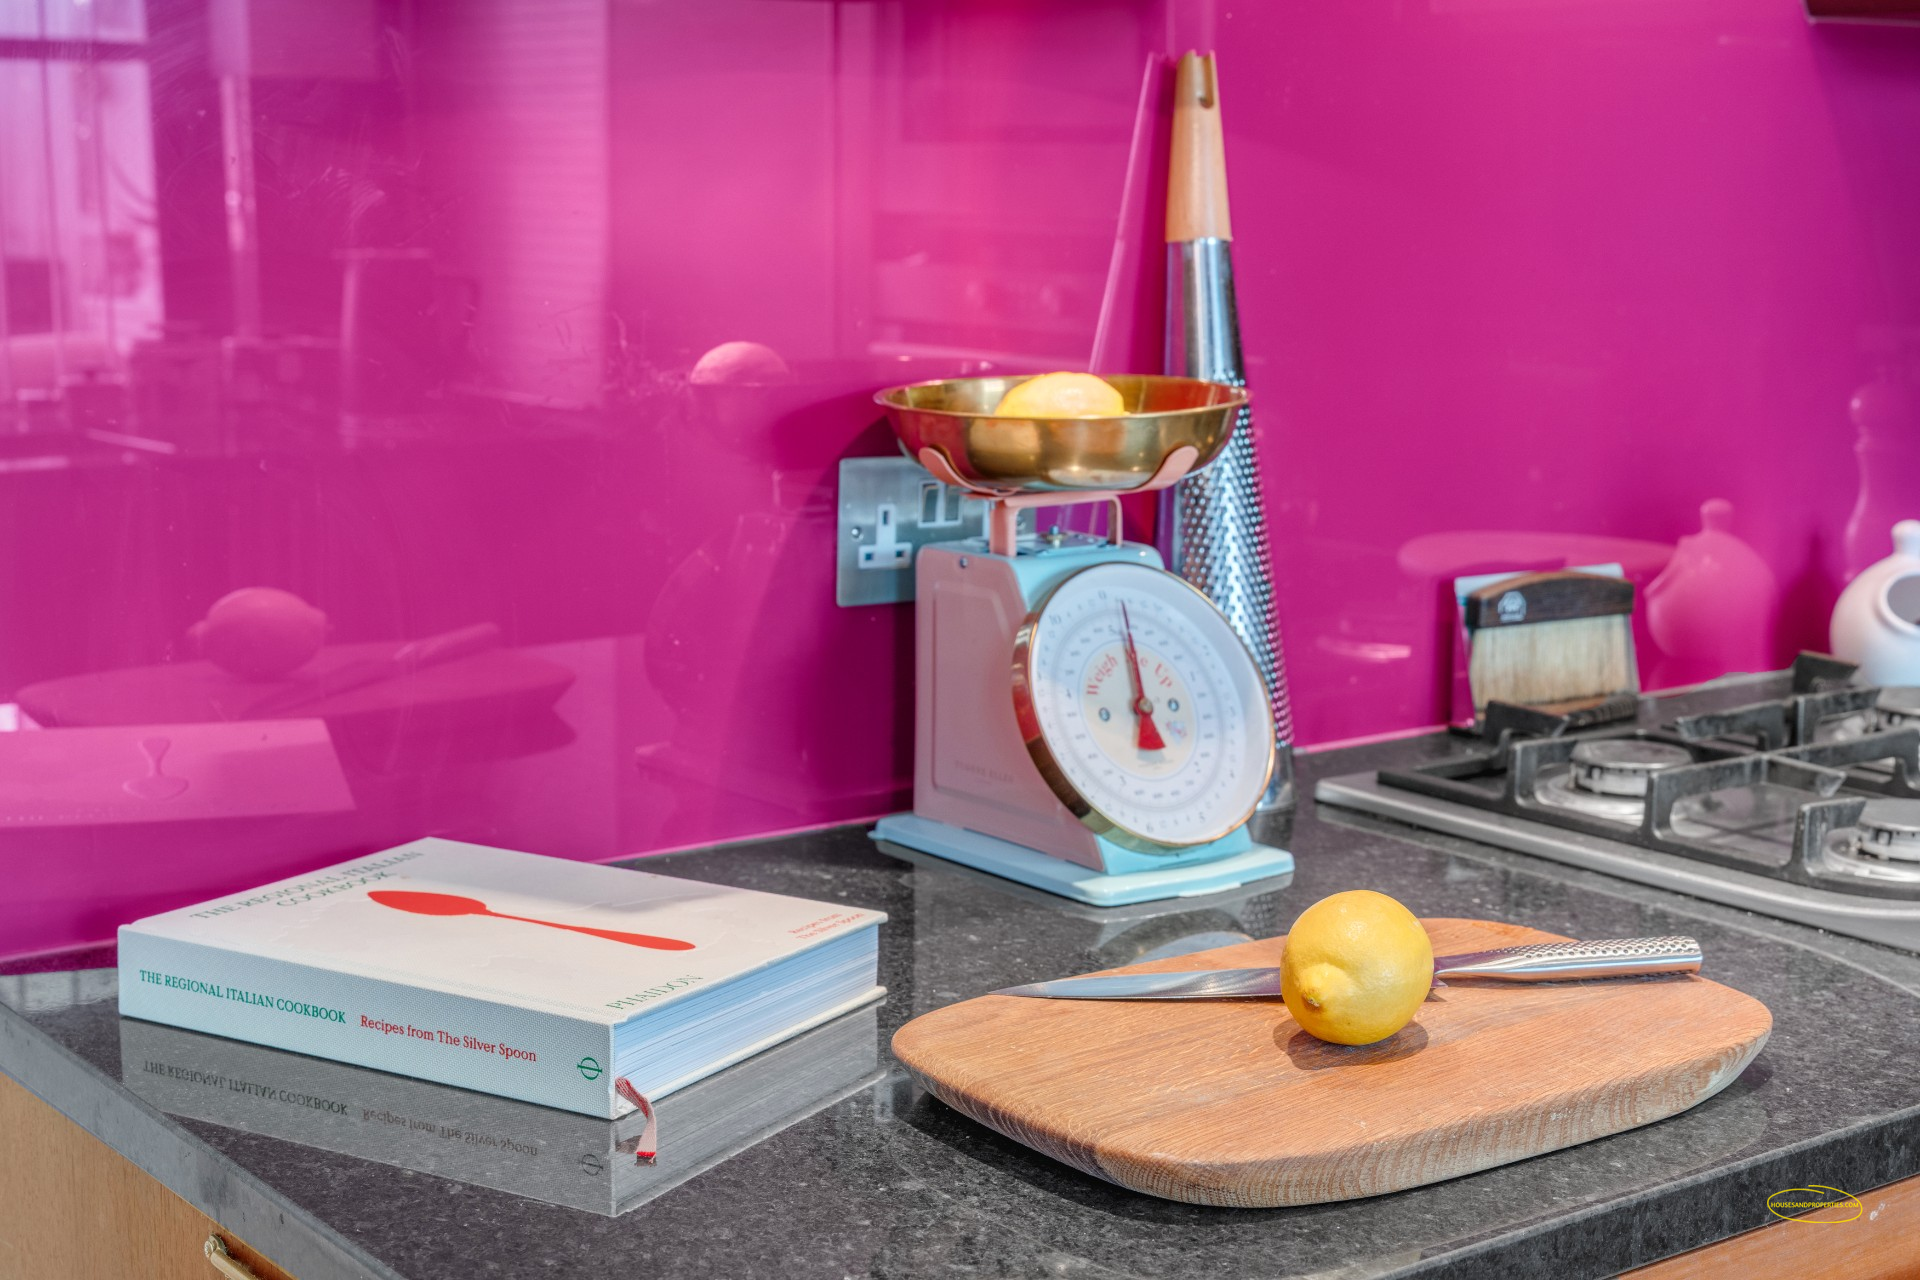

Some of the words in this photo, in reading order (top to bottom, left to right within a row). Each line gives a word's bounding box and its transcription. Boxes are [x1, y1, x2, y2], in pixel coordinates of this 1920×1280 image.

[1087, 653, 1118, 695] Weigh
[1155, 661, 1172, 689] Up
[190, 903, 242, 919] THE
[243, 870, 345, 906] REGIONAL
[343, 852, 424, 876] ITALIAN
[276, 870, 398, 907] COOKBOOK
[139, 969, 162, 985] THE
[164, 975, 223, 998] REGIONAL
[226, 987, 275, 1008] ITALIAN
[276, 998, 347, 1024] COOKBOOK
[605, 973, 704, 1010] PHAIDON
[360, 1015, 405, 1035] Recipes
[407, 1024, 434, 1041] from
[437, 1030, 460, 1046] The
[463, 1035, 496, 1054] Silver
[498, 1043, 537, 1062] Spoon
